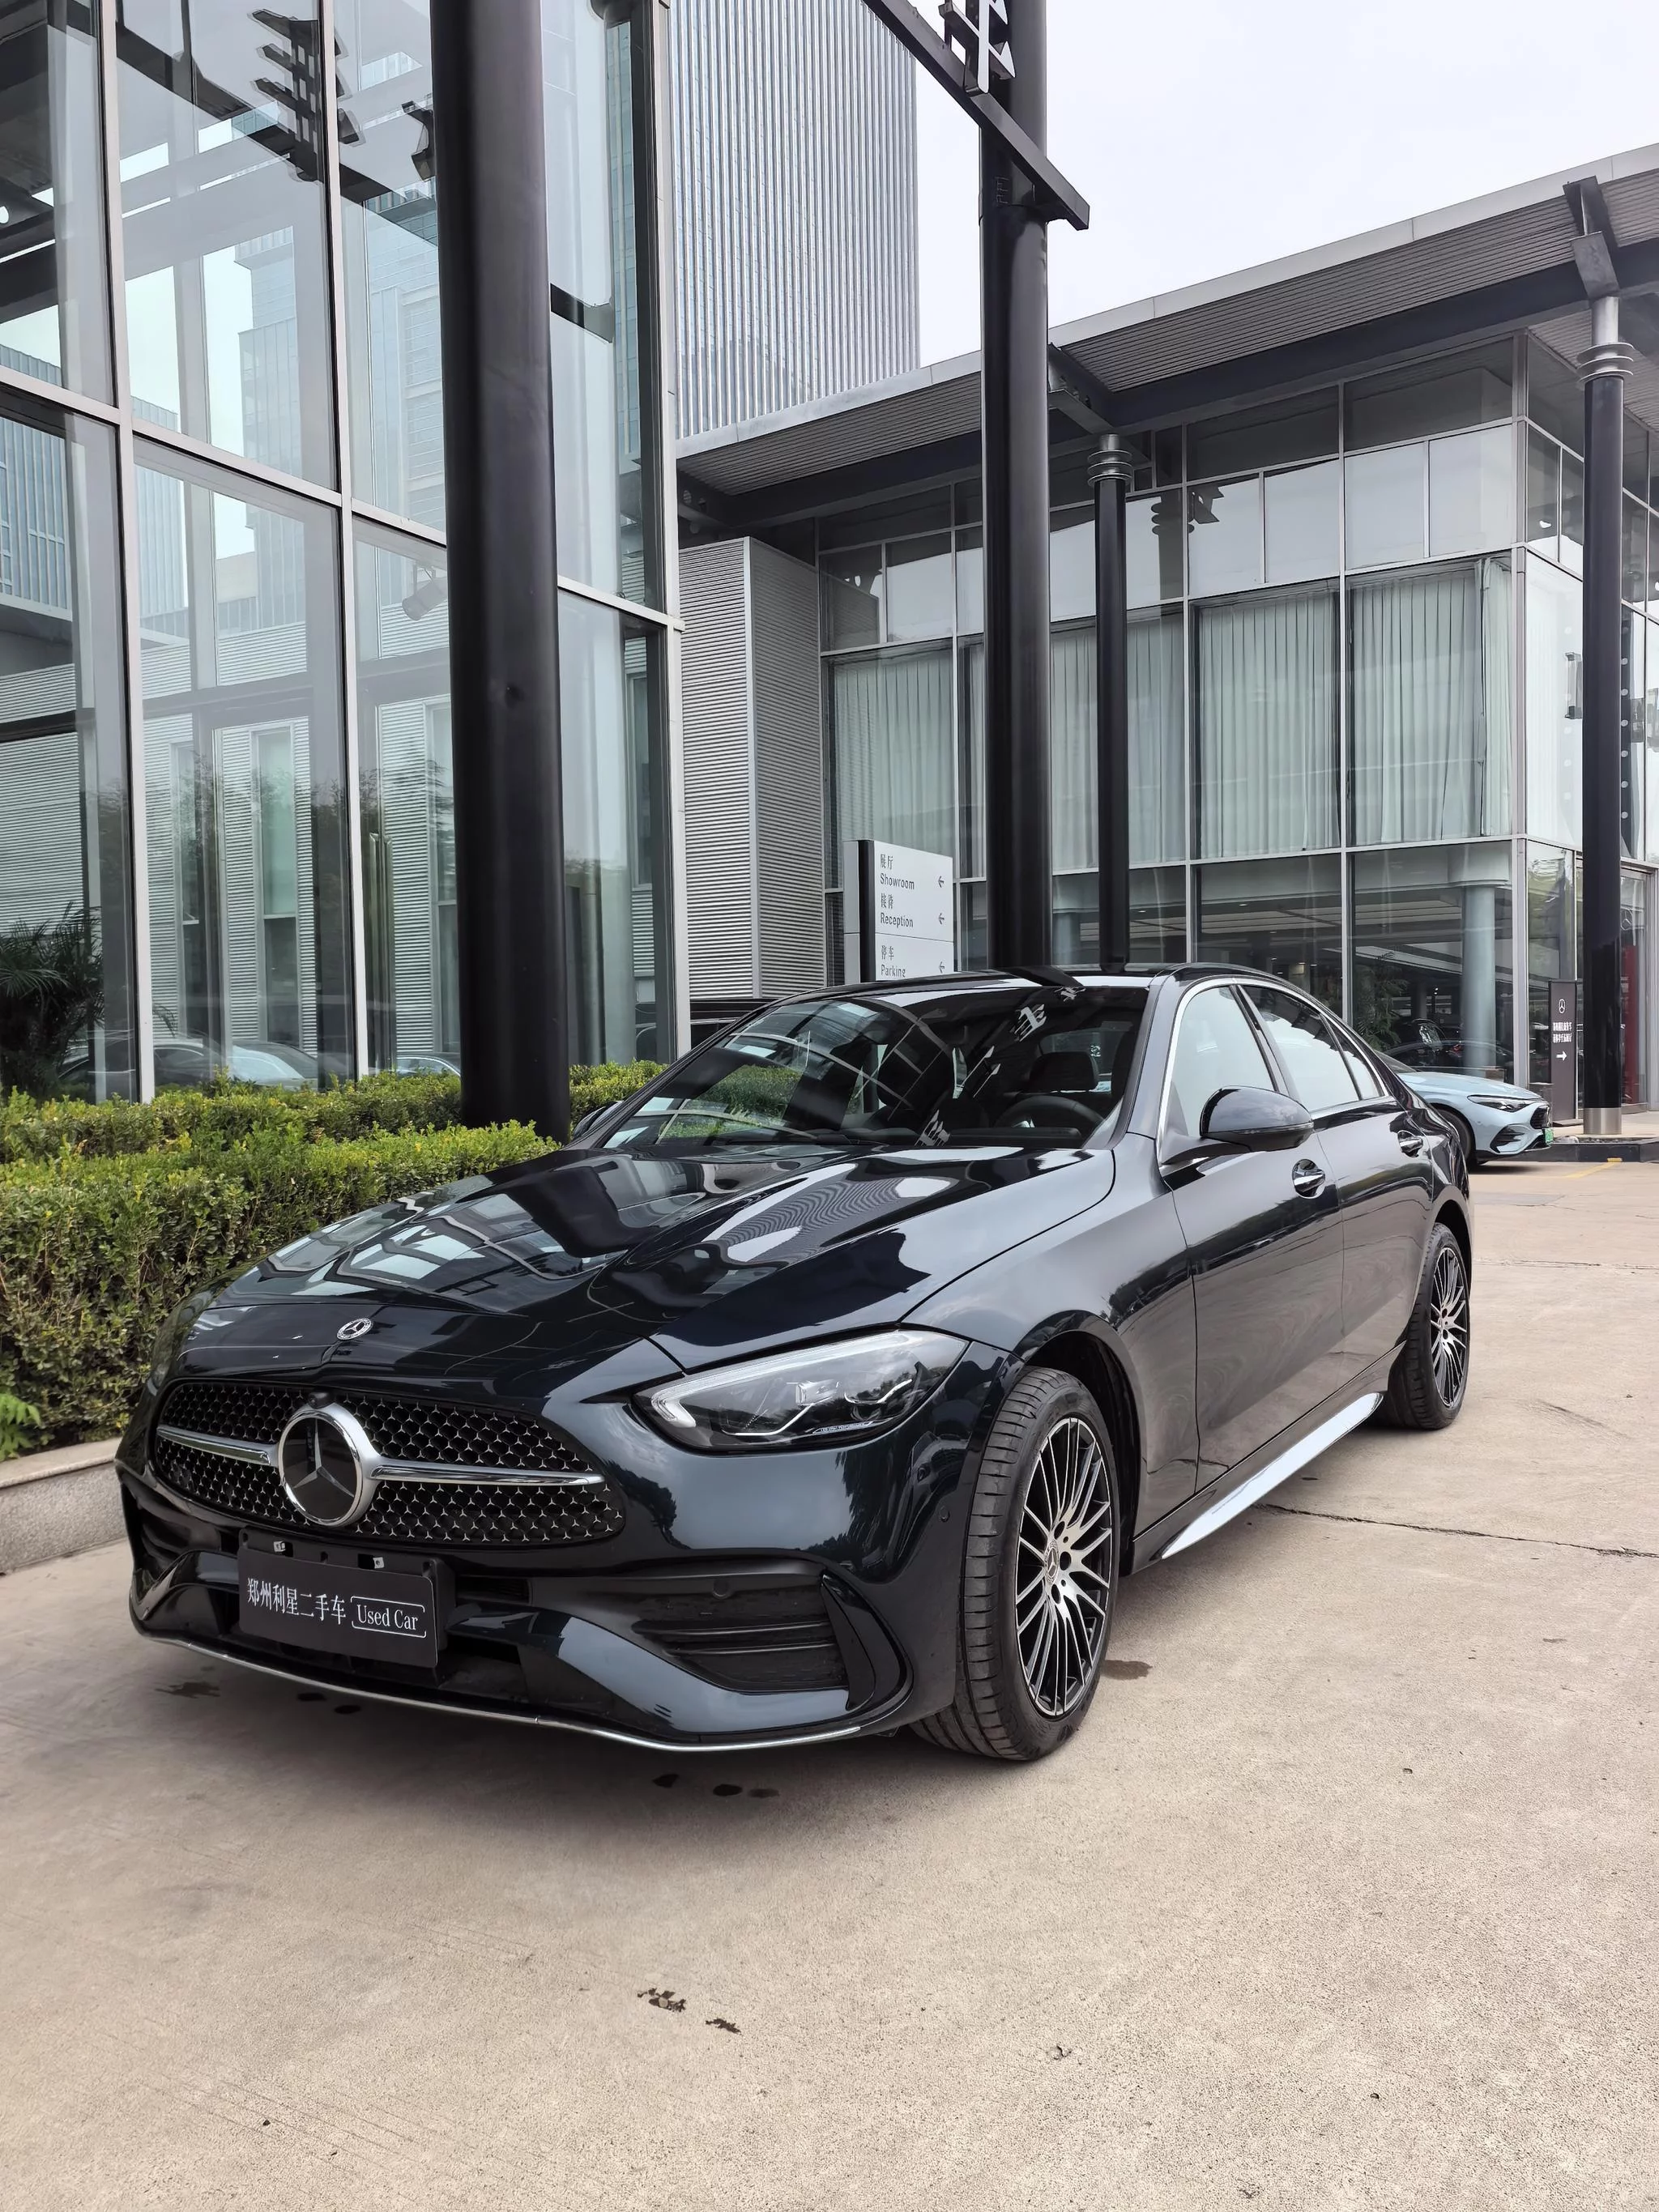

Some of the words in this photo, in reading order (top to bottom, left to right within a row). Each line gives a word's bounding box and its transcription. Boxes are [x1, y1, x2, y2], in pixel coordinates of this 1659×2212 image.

[880, 854, 893, 870] 展厅
[880, 872, 915, 890] Showroom
[881, 893, 893, 909] 接待
[880, 912, 914, 928] Reception
[881, 944, 894, 961] 停车
[881, 964, 906, 978] Parking
[247, 1577, 346, 1625] 郑州利星二手车
[356, 1604, 390, 1627] Used
[394, 1609, 419, 1630] Car
